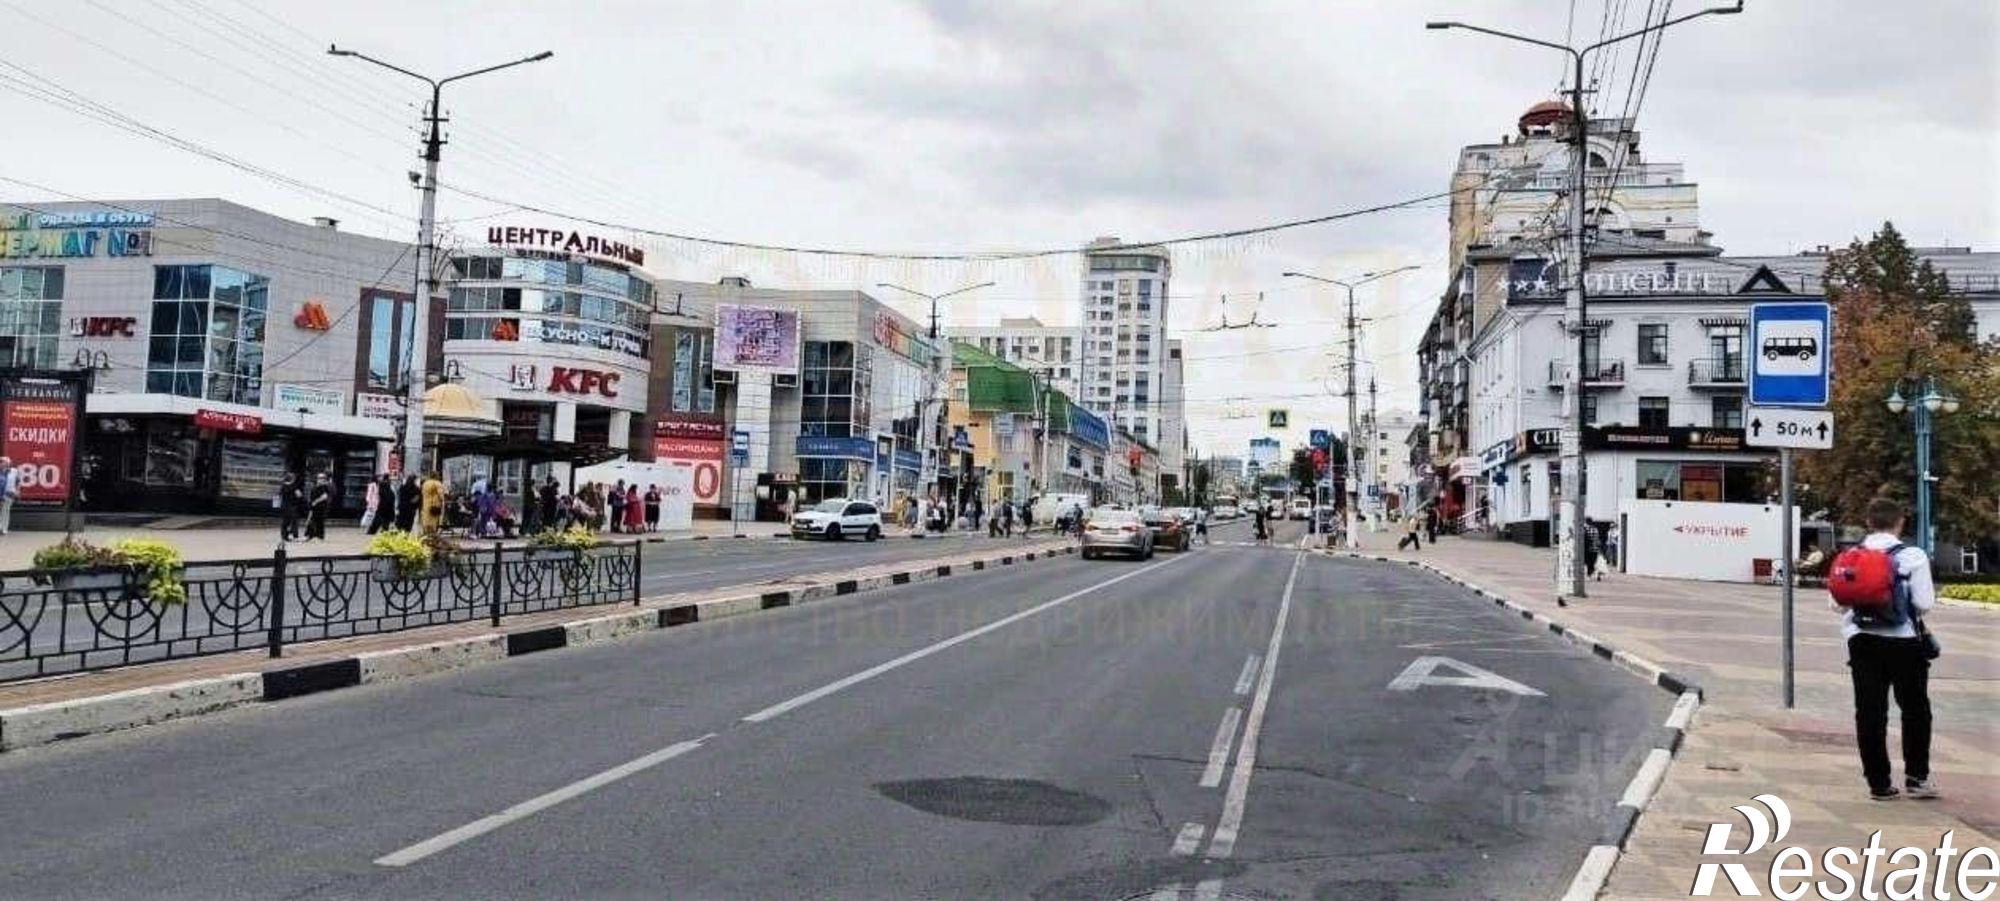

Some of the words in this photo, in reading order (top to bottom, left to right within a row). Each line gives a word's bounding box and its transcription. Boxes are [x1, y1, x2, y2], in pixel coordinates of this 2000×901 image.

[488, 226, 645, 266] ЦЕНТРАЛЬНЫЙ
[547, 365, 621, 398] KFC
[9, 427, 67, 444] СКИДКИ
[1777, 421, 1798, 436] 50
[18, 462, 60, 489] 80
[1685, 524, 1750, 538] УКРЫТИЕ
